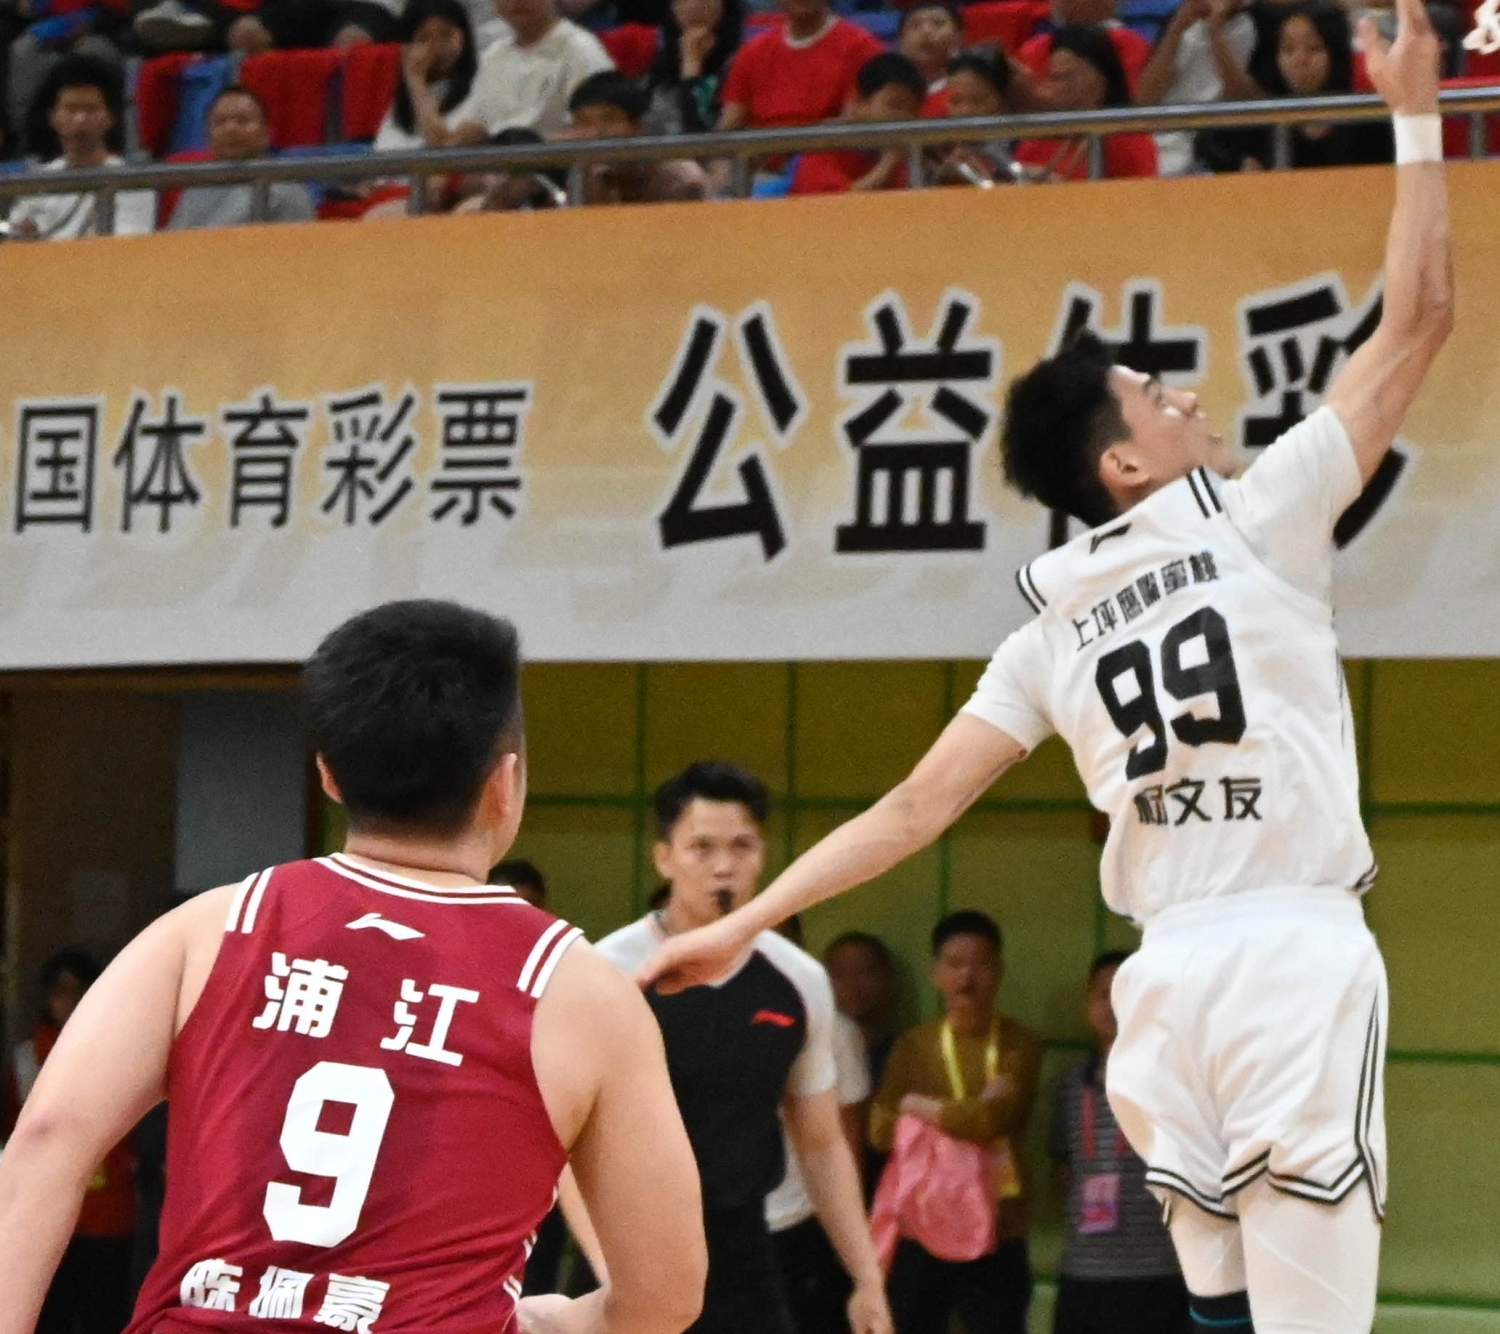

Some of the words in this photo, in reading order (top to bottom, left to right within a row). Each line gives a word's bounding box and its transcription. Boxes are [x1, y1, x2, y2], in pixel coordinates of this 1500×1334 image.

[1095, 605, 1248, 782] 99
[250, 948, 483, 1069] 浦江
[259, 1060, 396, 1249] 9
